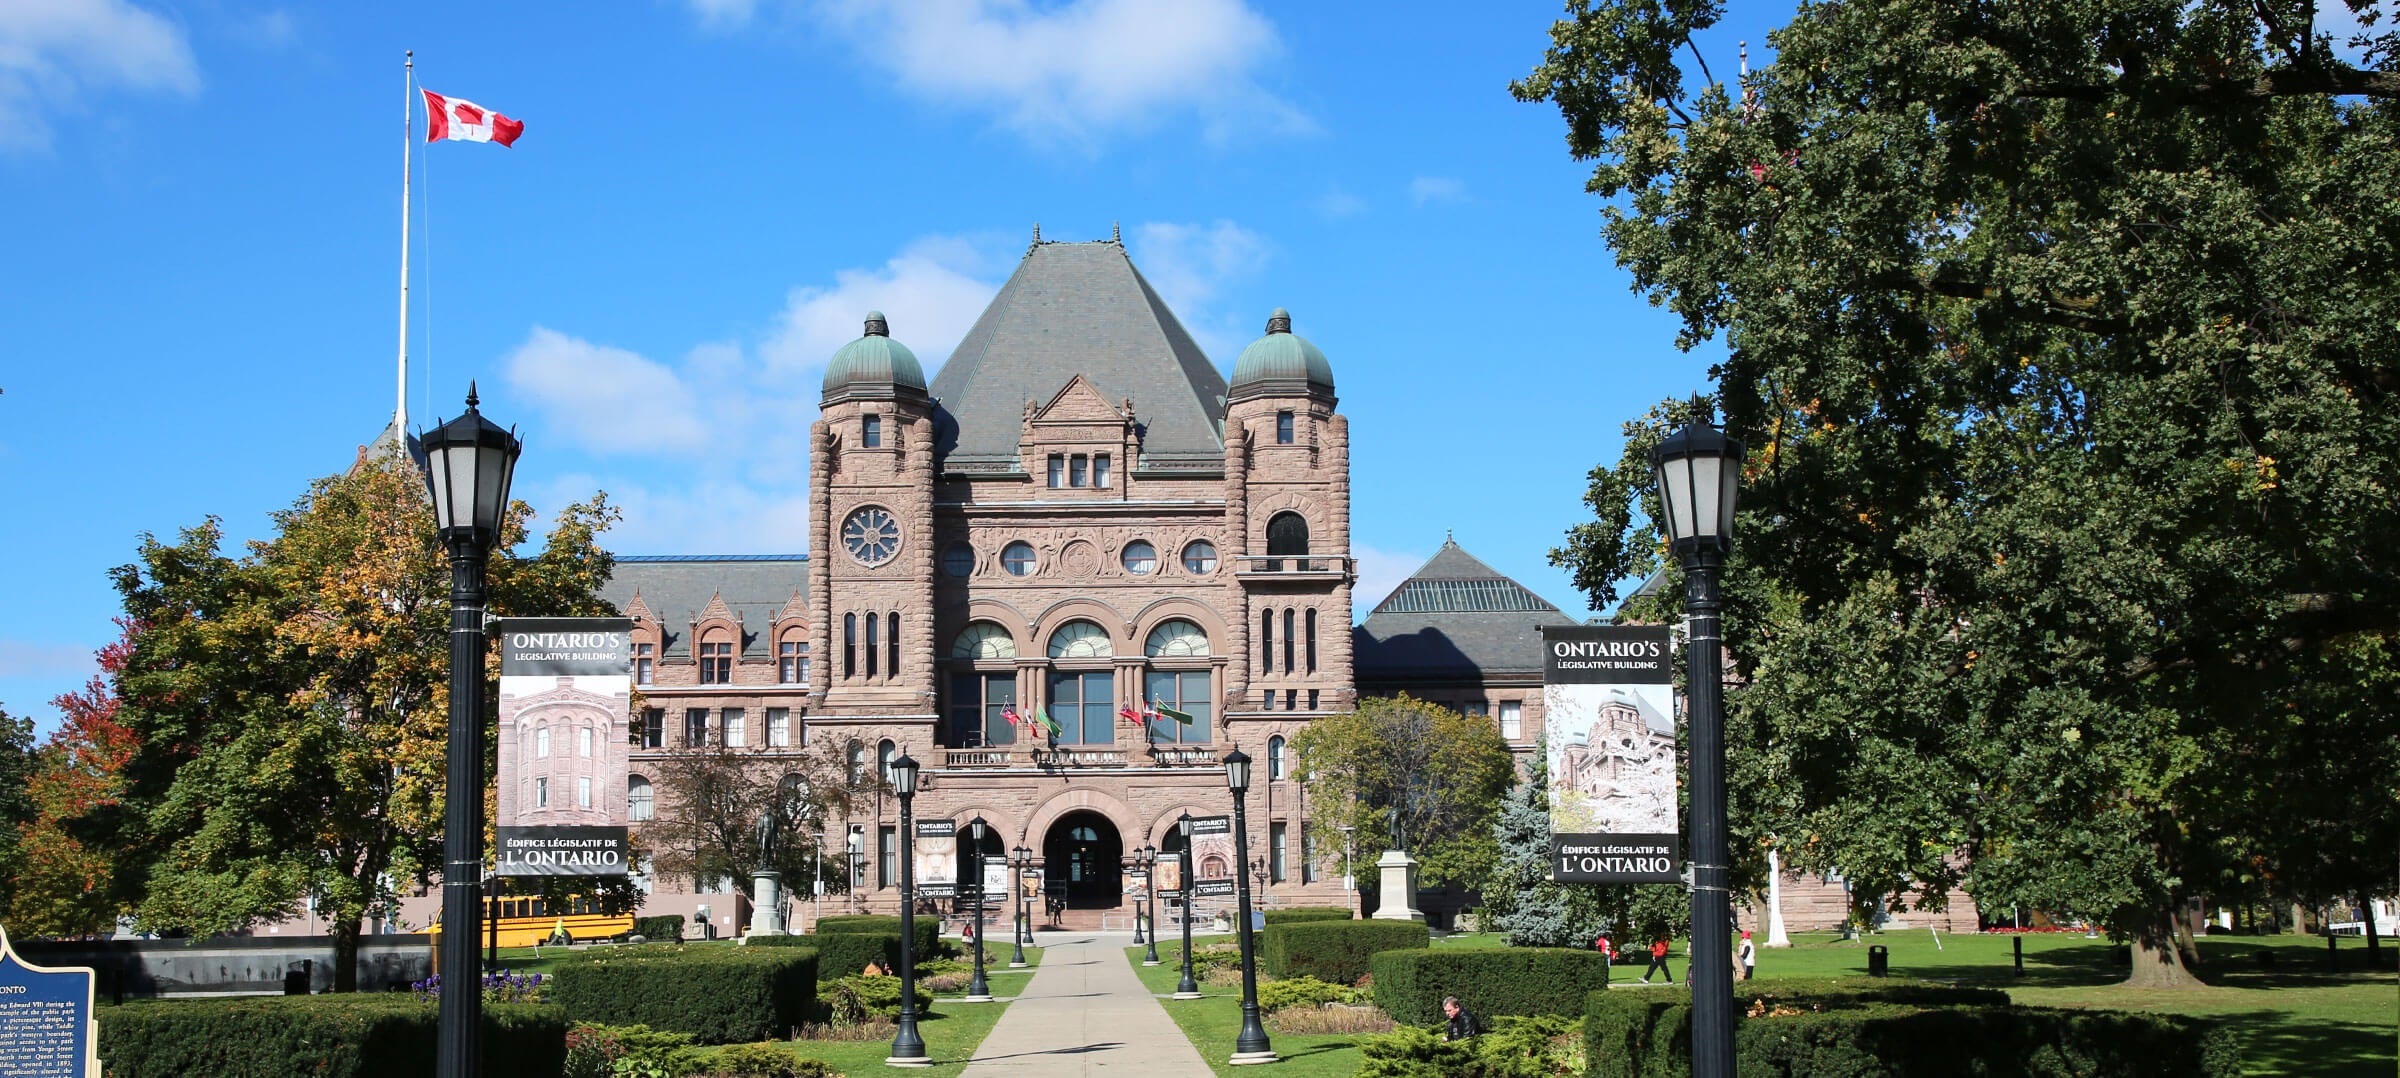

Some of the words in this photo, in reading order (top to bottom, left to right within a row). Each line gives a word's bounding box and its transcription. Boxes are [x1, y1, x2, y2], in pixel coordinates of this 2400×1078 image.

[513, 632, 619, 649] ONTARIO'S
[1554, 640, 1660, 657] ONTARIO'S
[515, 652, 570, 661] LEGISLATIVE
[572, 652, 617, 660] BUILDING
[1558, 661, 1612, 669] LEGISLATIVE
[1614, 661, 1658, 669] BUILDING
[507, 838, 546, 848] ÉDIFICE
[548, 838, 602, 848] LÉGISLATIF
[604, 839, 618, 847] DE
[1562, 845, 1600, 854] ÉDIFICE
[1602, 845, 1655, 854] LÉGISLATIF
[1657, 846, 1670, 854] DE
[505, 849, 619, 866] L'ONTARIO
[1562, 856, 1671, 873] L'ONTARIO
